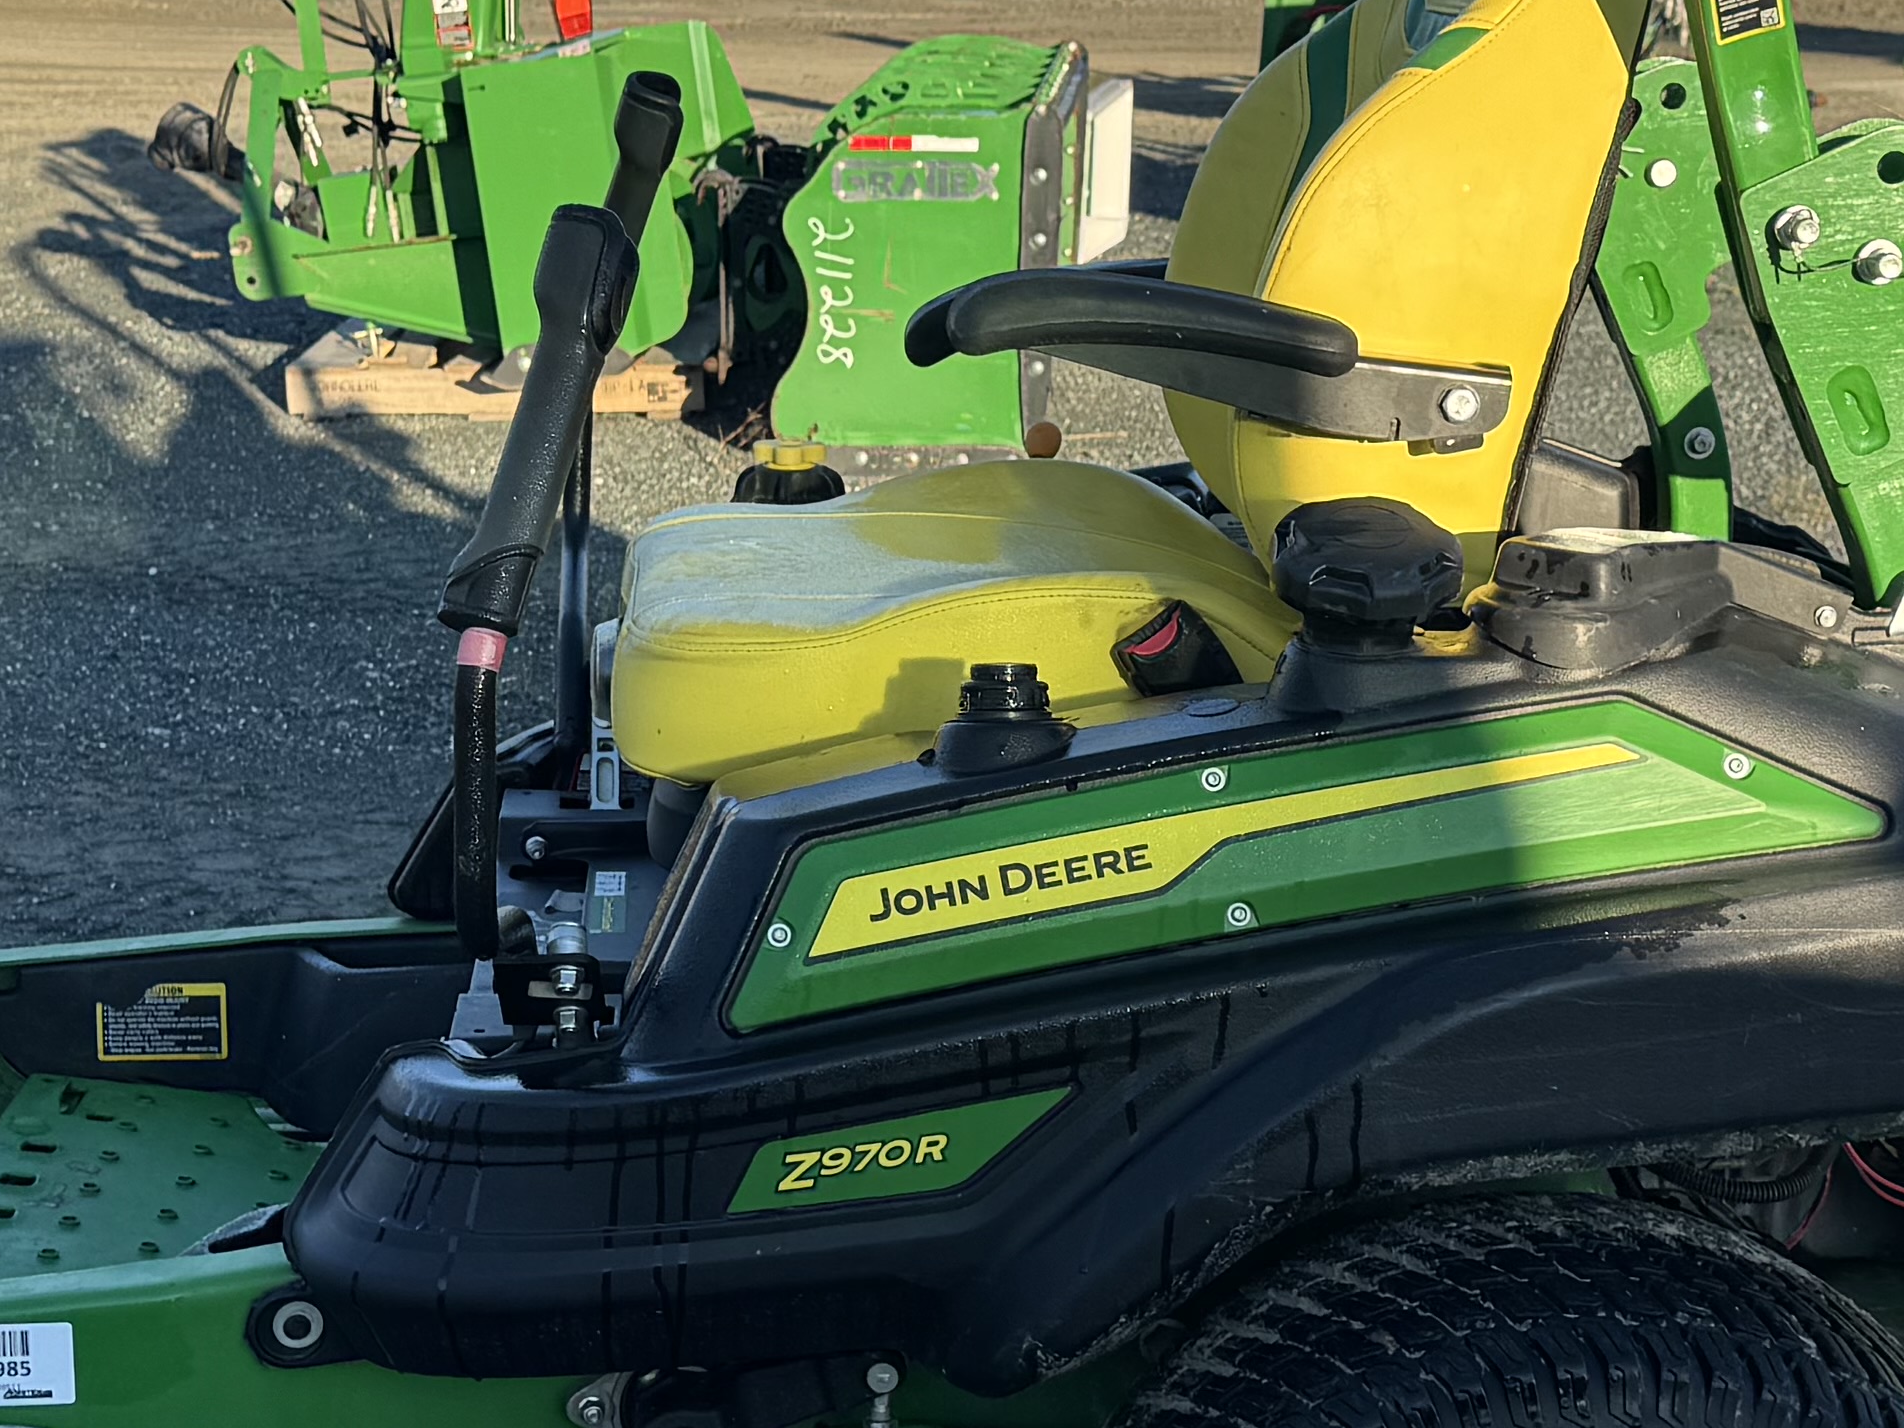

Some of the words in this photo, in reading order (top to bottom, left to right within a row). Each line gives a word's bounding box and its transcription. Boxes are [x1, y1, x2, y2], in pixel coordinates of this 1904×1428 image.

[869, 874, 990, 923] JOHN
[998, 843, 1153, 897] DEERE
[776, 1133, 949, 1193] Z970R
